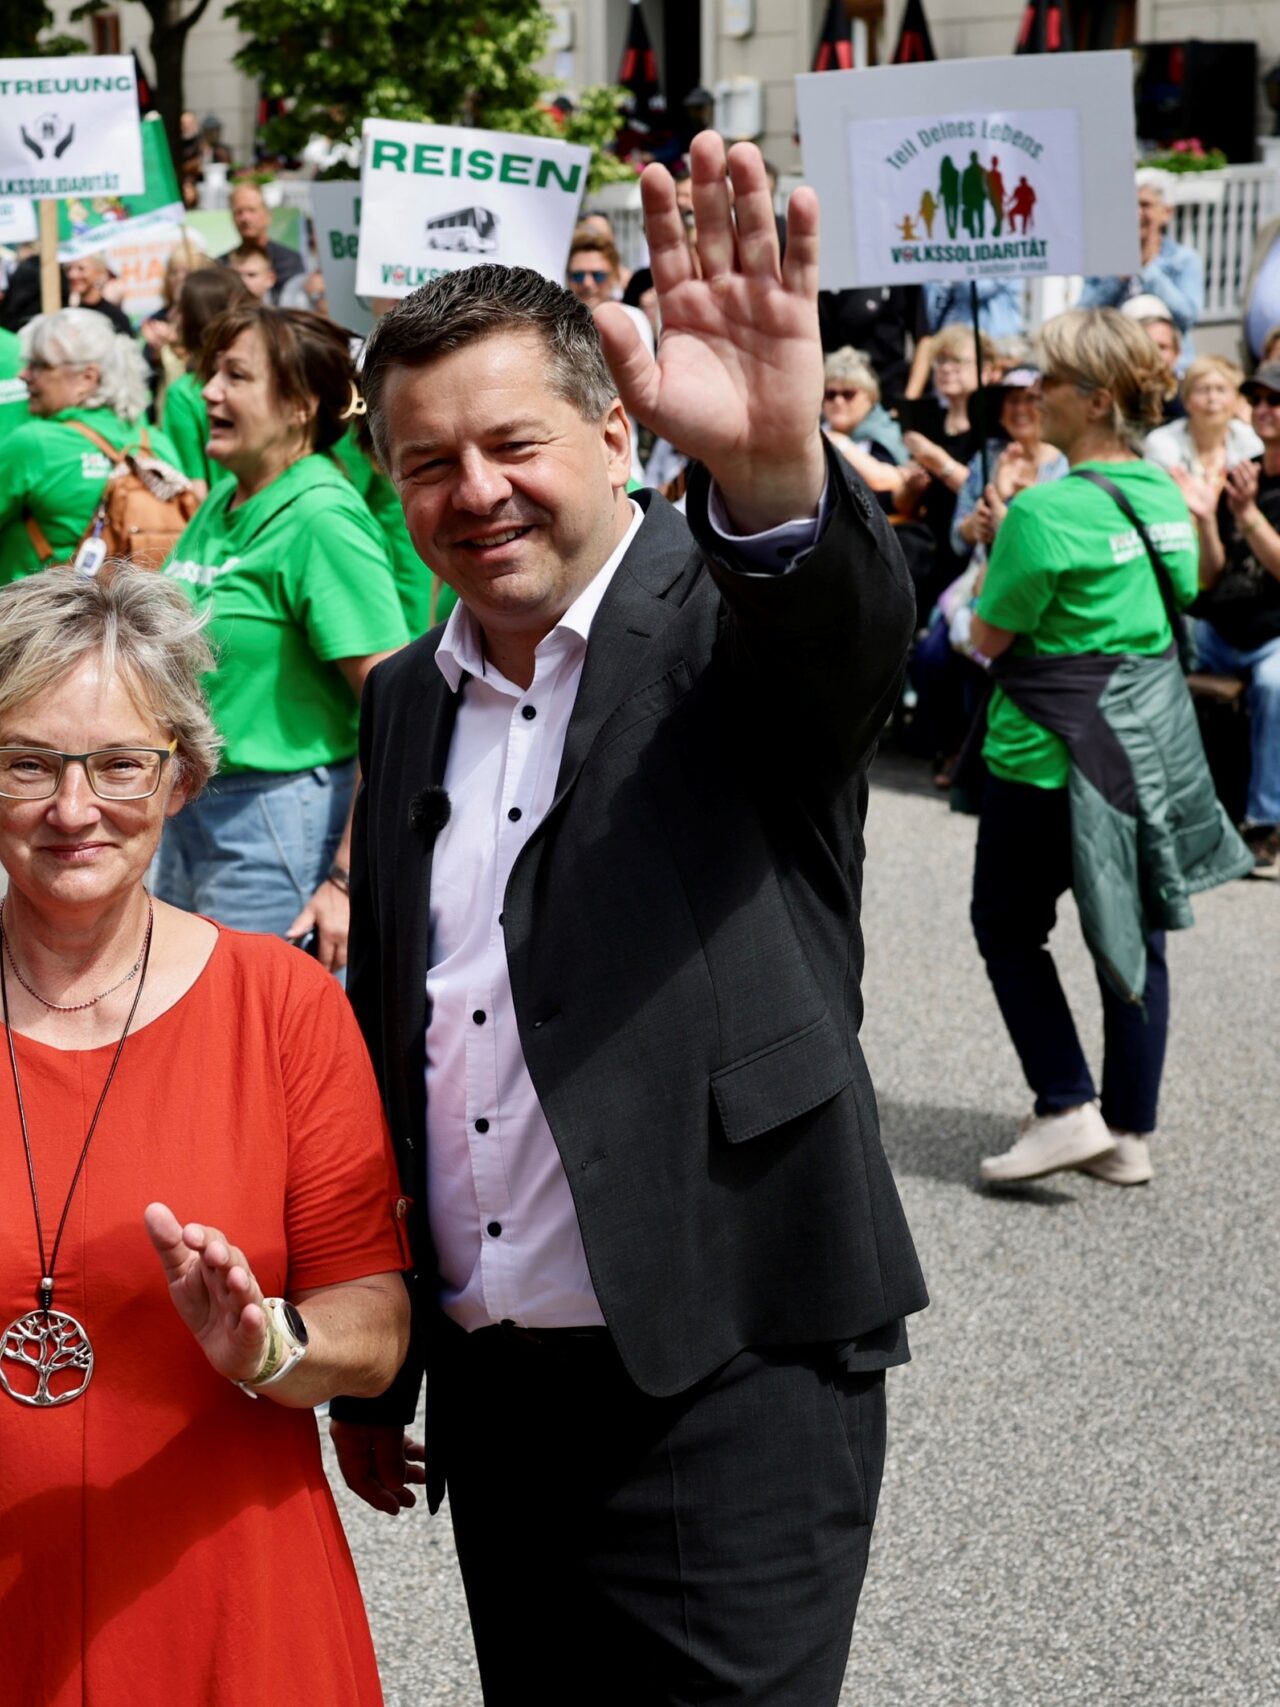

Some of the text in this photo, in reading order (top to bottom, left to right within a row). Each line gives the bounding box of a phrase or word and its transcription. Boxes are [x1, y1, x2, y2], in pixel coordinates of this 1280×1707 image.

[372, 139, 582, 193] REISEN
[885, 118, 1045, 170] Teil Deines Lebens
[890, 238, 1048, 264] VOLKSSOLIDARITÄT
